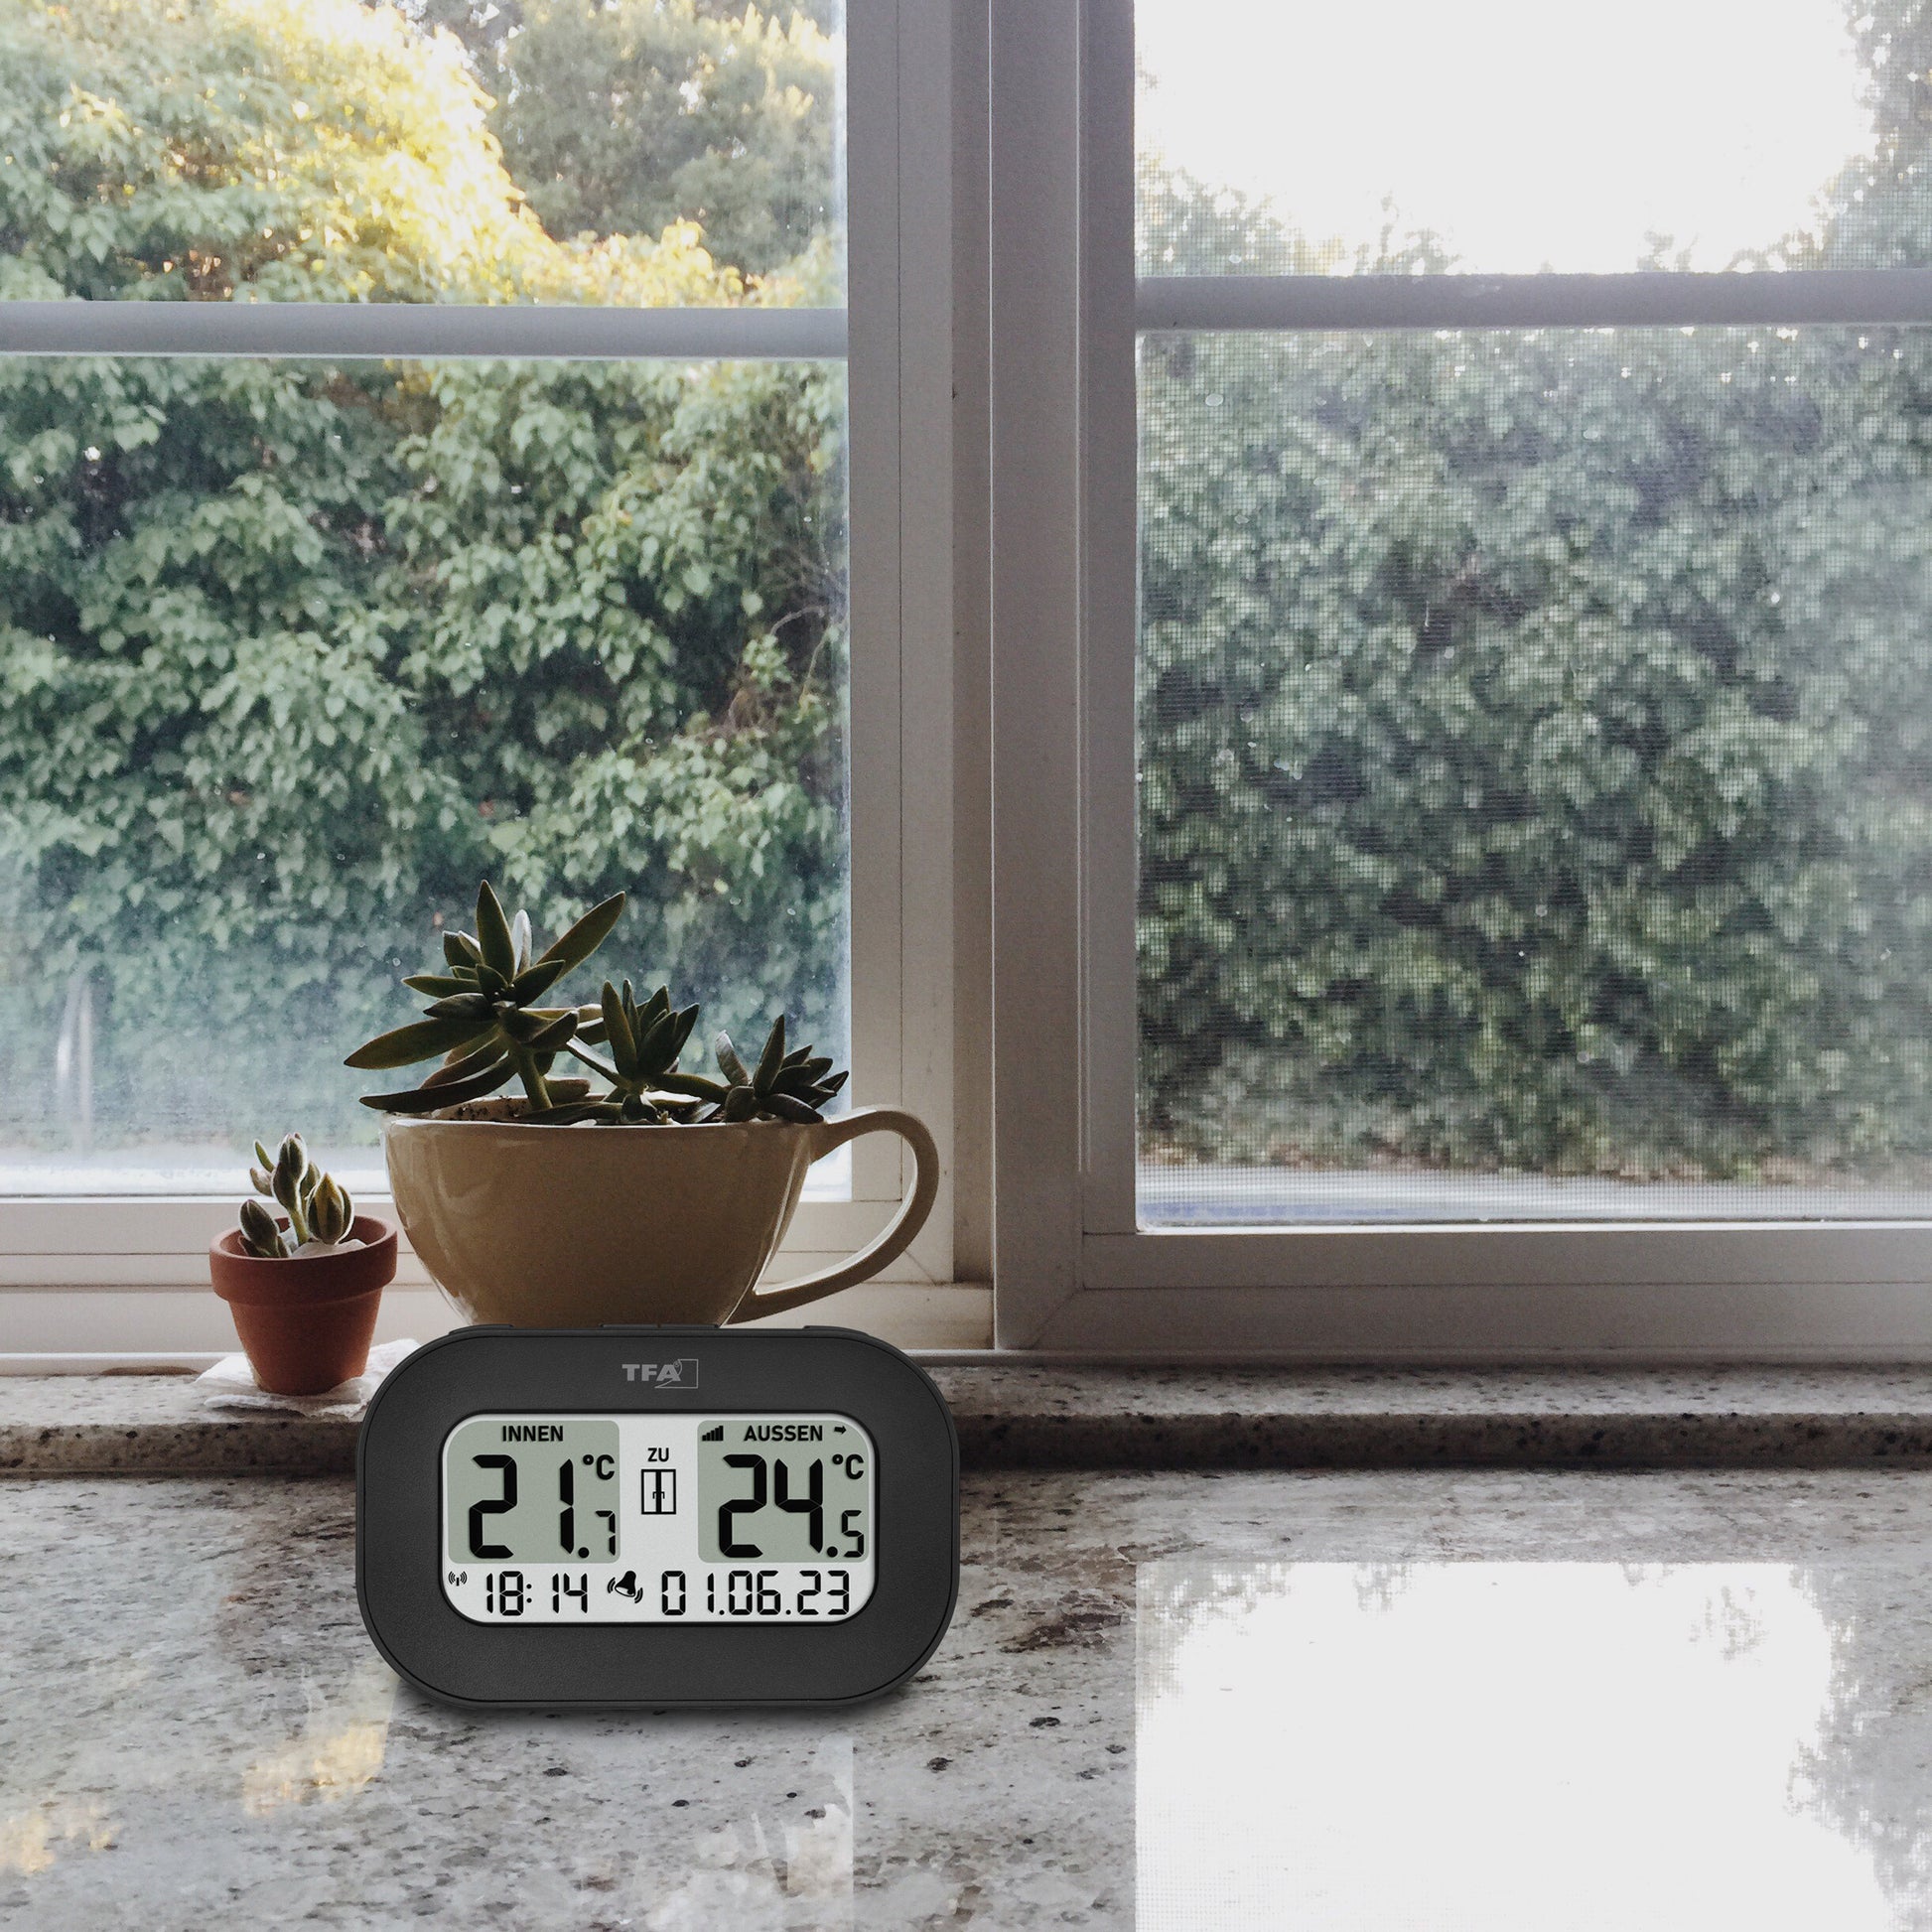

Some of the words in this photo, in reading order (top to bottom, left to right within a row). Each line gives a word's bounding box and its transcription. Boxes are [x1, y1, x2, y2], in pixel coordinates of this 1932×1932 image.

[621, 1364, 682, 1382] TFA
[501, 1426, 564, 1442] INNEN
[744, 1425, 823, 1442] AUSSEN
[647, 1448, 670, 1462] ZU
[469, 1454, 616, 1559] 21.7
[582, 1453, 616, 1480] °C
[718, 1453, 865, 1559] 24.5
[832, 1453, 865, 1480] °C
[661, 1570, 851, 1616] 01.06.23
